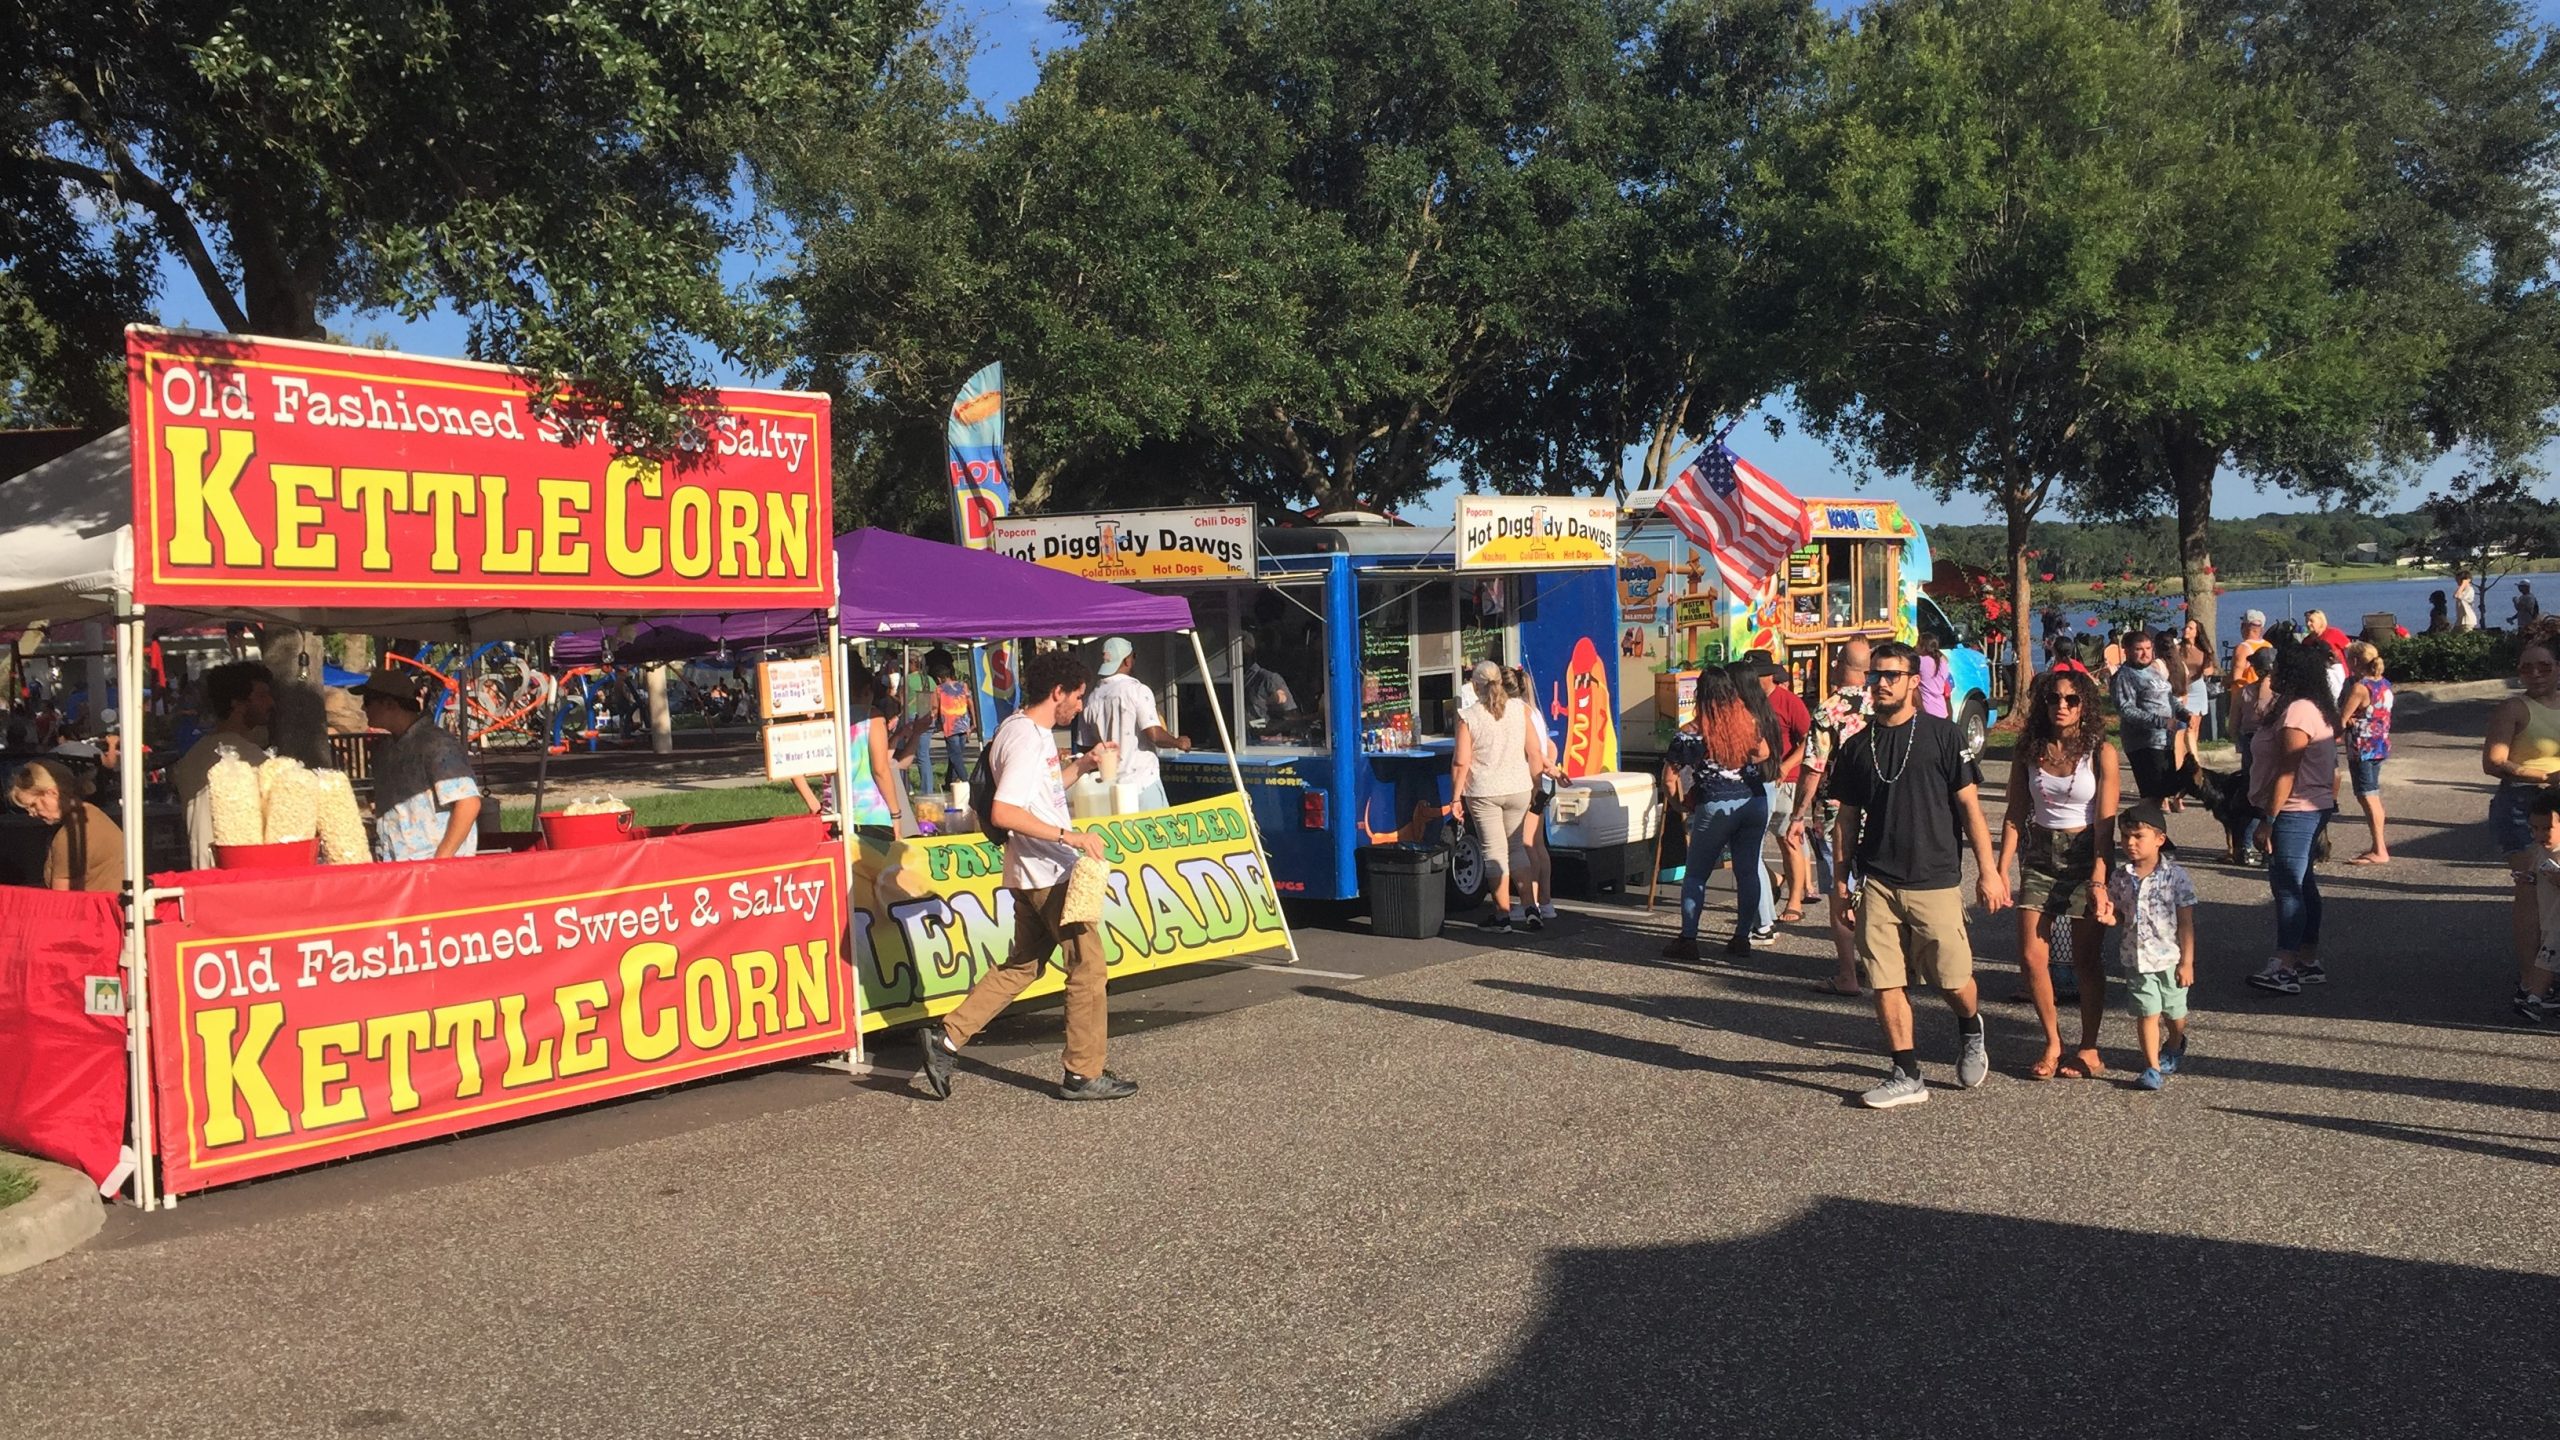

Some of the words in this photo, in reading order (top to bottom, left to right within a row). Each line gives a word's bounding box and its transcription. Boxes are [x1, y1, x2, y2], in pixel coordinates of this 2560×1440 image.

[162, 367, 255, 421] Old
[272, 375, 525, 441] Fashioned
[718, 415, 808, 473] Salty
[949, 459, 1002, 488] HOT
[1466, 507, 1493, 517] Popcorn
[1827, 509, 1860, 530] KONA
[1860, 508, 1878, 530] ICE
[1194, 516, 1218, 527] Chili
[1220, 514, 1247, 527] Dogs
[998, 527, 1037, 539] Popcorn
[1467, 521, 1492, 551] Hot
[1568, 517, 1612, 549] Dawgs
[1159, 529, 1243, 563] Dawgs
[1563, 550, 1575, 559] Hot
[1576, 550, 1592, 560] Dogs
[1082, 568, 1104, 578] Cold
[1105, 567, 1137, 577] Drinks
[1153, 564, 1173, 575] Hot
[1175, 563, 1204, 576] Dogs
[1227, 563, 1245, 572] Inc.
[1628, 581, 1649, 597] ICE
[785, 751, 803, 761] Water
[193, 946, 280, 1000] Old
[297, 912, 543, 989] Fashioned
[554, 892, 680, 950] Sweet
[690, 886, 720, 928] &
[728, 873, 825, 923] Salty
[854, 850, 1284, 1012] LEMNADE
